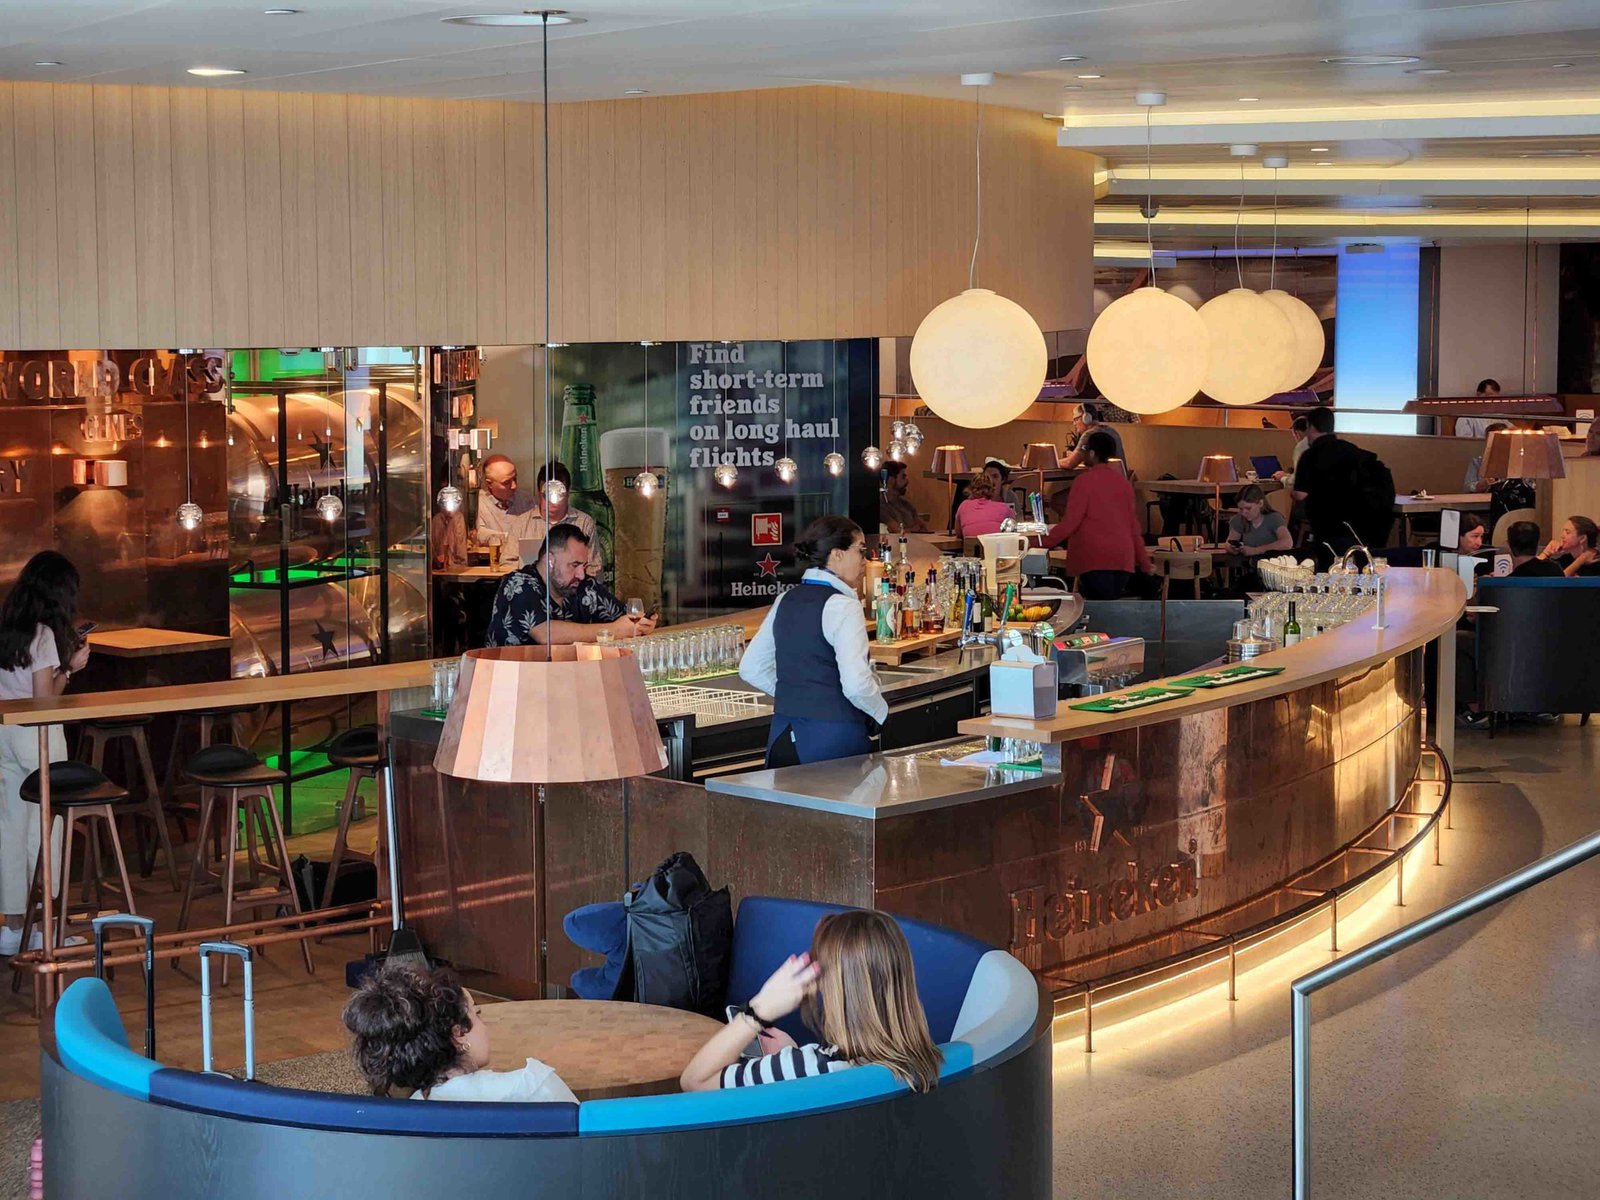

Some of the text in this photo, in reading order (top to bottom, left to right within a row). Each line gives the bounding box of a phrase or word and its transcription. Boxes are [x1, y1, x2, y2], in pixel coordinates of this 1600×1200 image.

[690, 343, 744, 364] Find
[690, 369, 823, 390] short-term
[690, 394, 780, 415] friends
[690, 418, 840, 444] on long haul
[579, 427, 588, 472] Heineken
[731, 581, 800, 597] Heineke
